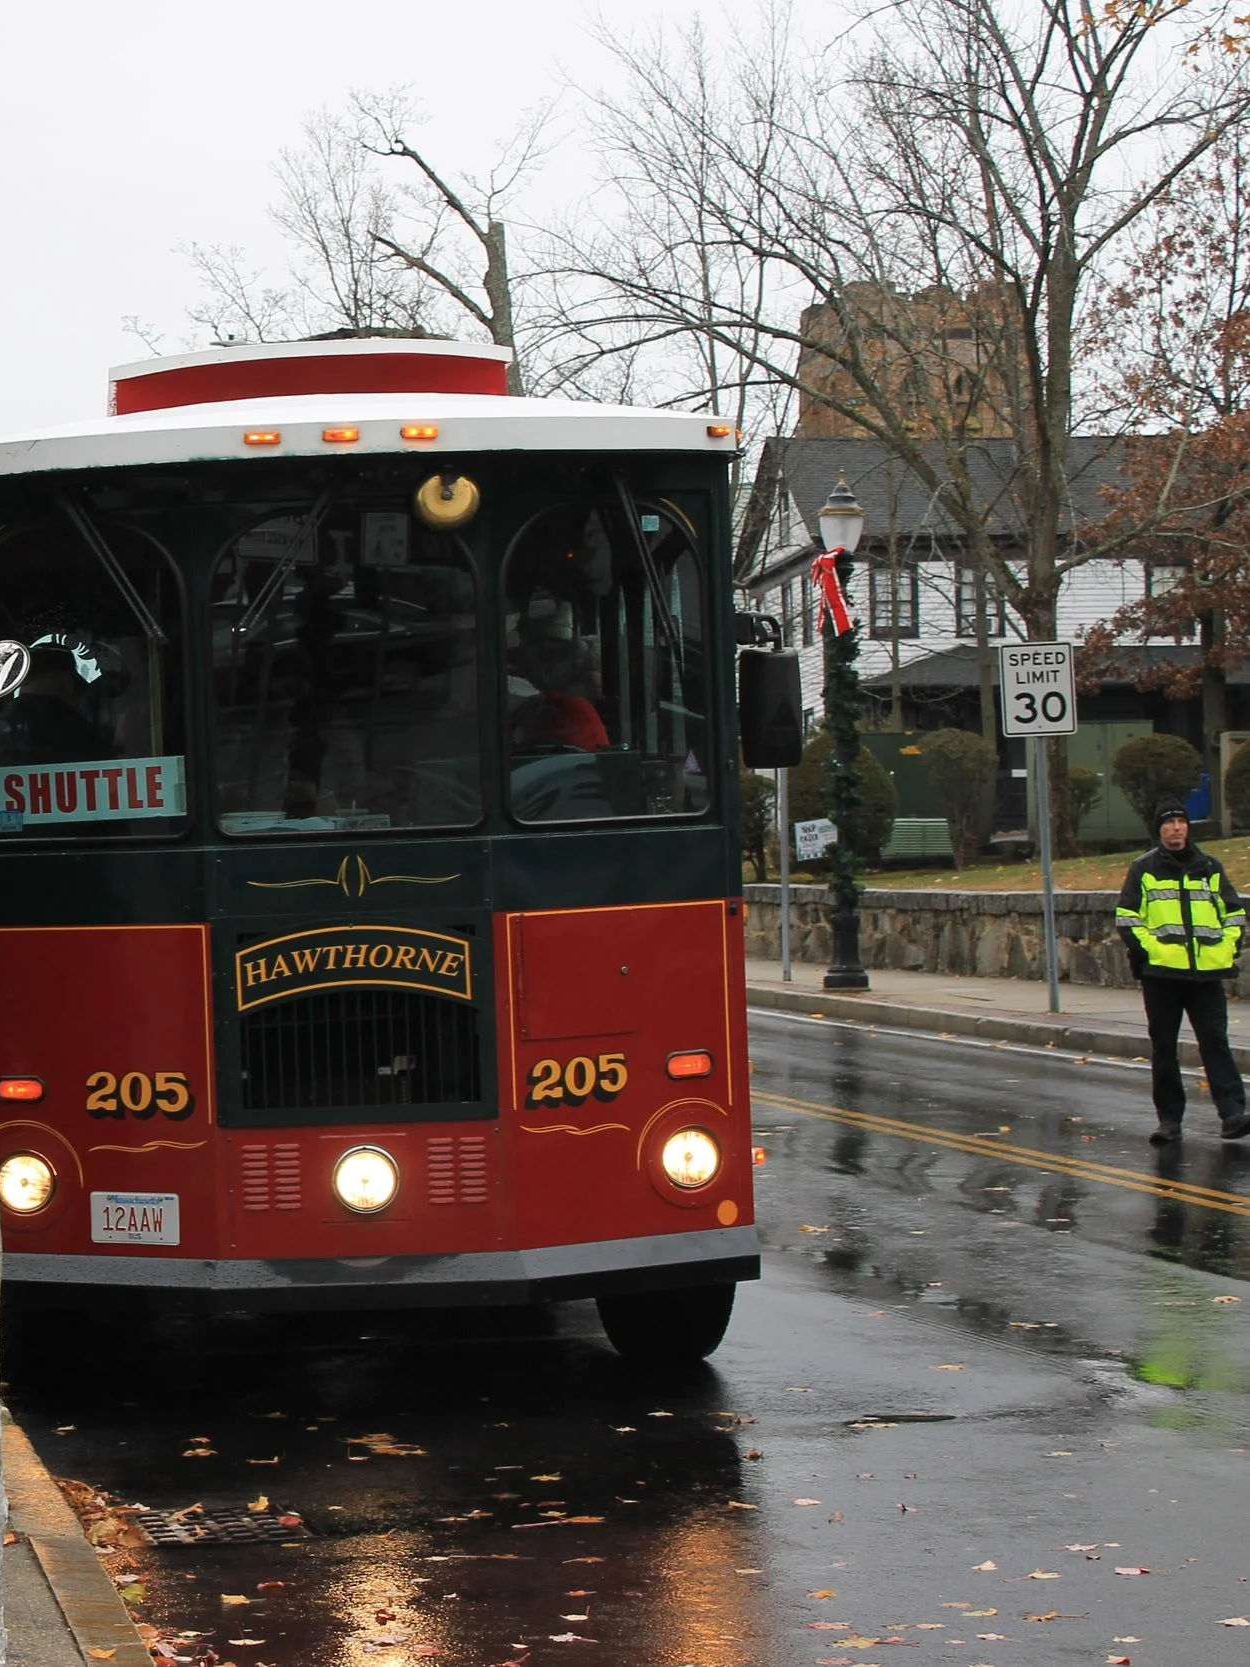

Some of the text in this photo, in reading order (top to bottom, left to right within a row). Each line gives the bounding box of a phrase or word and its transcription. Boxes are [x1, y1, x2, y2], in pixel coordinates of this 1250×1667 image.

[1009, 652, 1066, 666] SPEED
[1016, 670, 1060, 684] LIMIT
[1014, 691, 1067, 724] 30
[4, 766, 164, 814] SHUTTLE
[244, 944, 464, 987] HAWTHORNE
[86, 1071, 189, 1113] 205
[532, 1053, 628, 1100] 205
[103, 1206, 163, 1233] 12AAW
